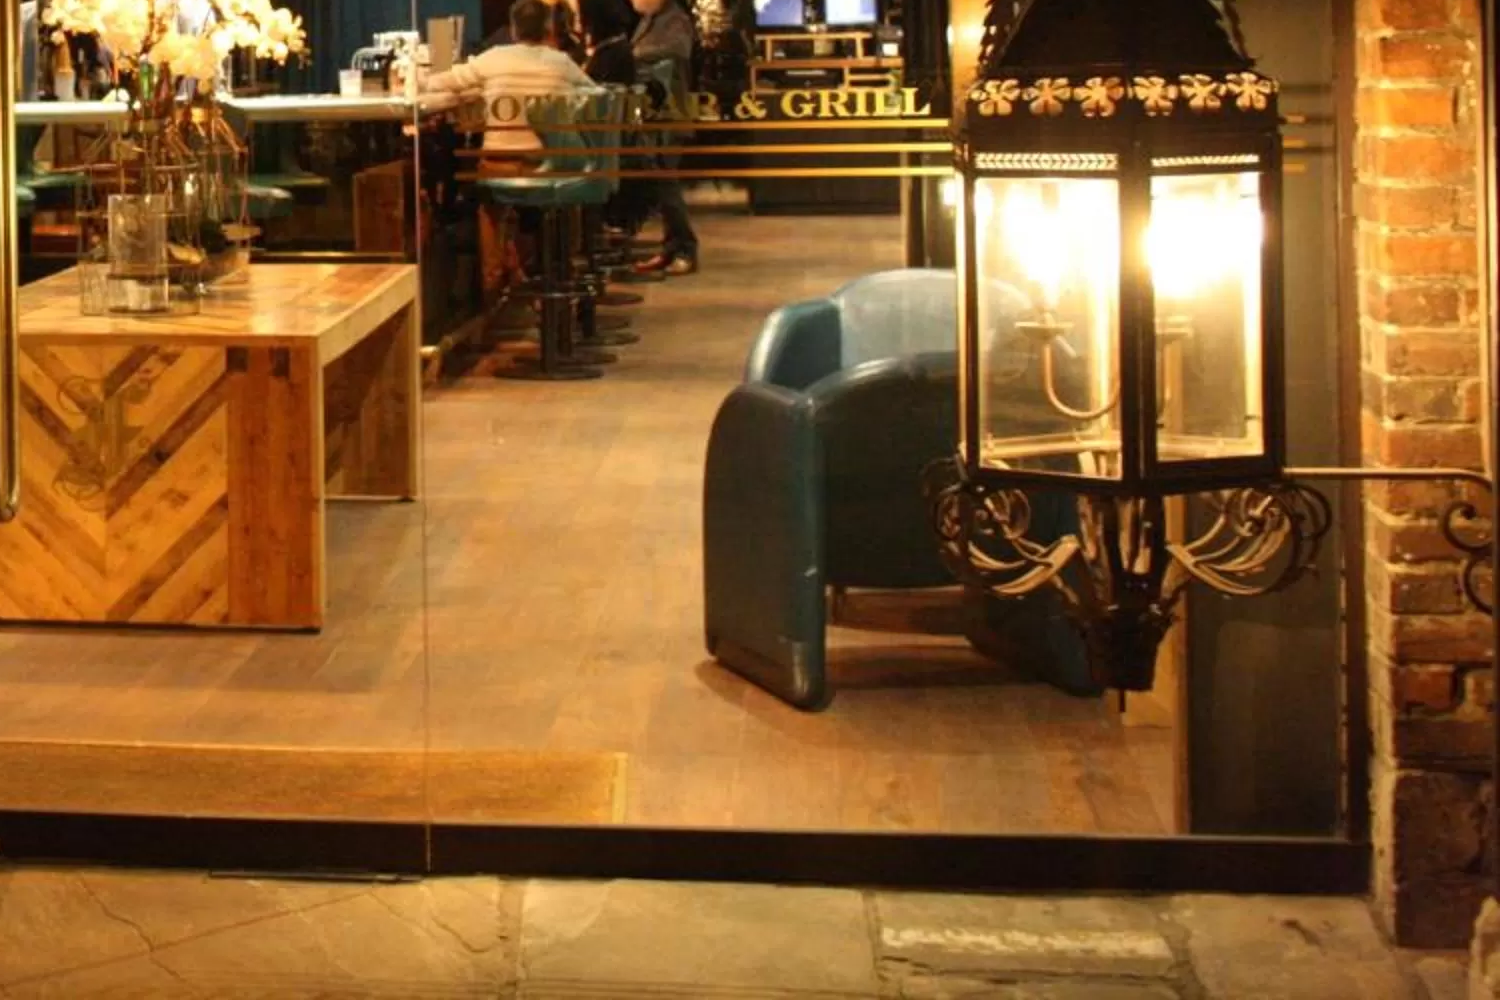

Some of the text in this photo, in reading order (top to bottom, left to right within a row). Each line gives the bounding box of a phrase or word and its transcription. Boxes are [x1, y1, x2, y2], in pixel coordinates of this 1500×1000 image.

[457, 92, 616, 123] OTEL
[734, 90, 768, 119] &
[780, 87, 931, 118] GRILL
